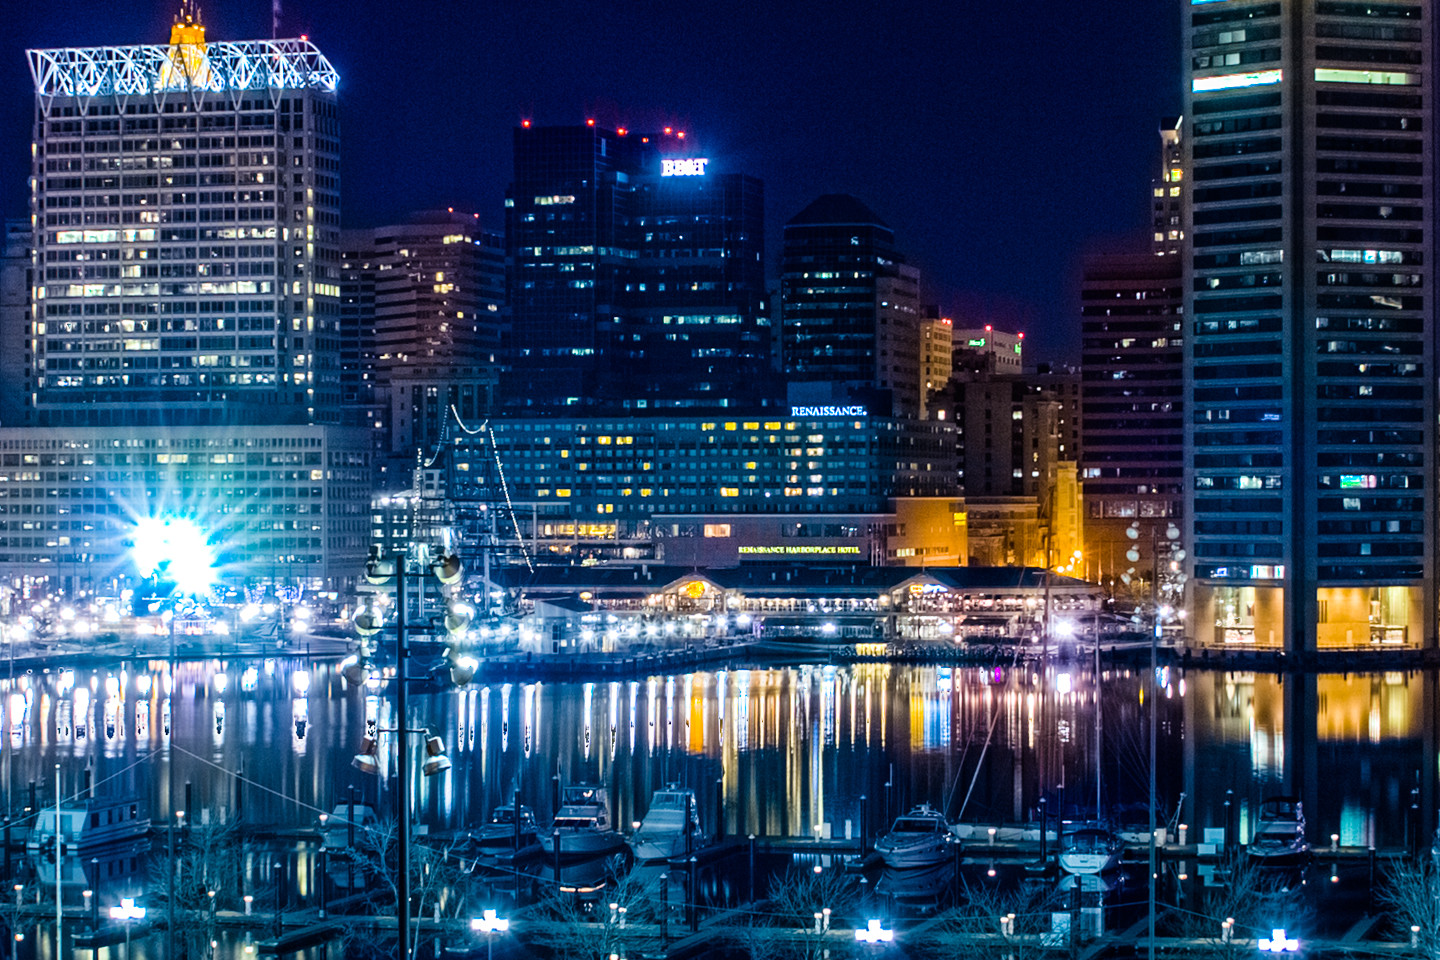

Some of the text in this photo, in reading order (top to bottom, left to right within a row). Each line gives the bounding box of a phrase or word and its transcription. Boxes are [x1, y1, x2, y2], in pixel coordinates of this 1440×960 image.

[661, 158, 708, 176] BB&T
[738, 546, 785, 554] RENAISSANCE
[837, 546, 861, 554] HOTEL
